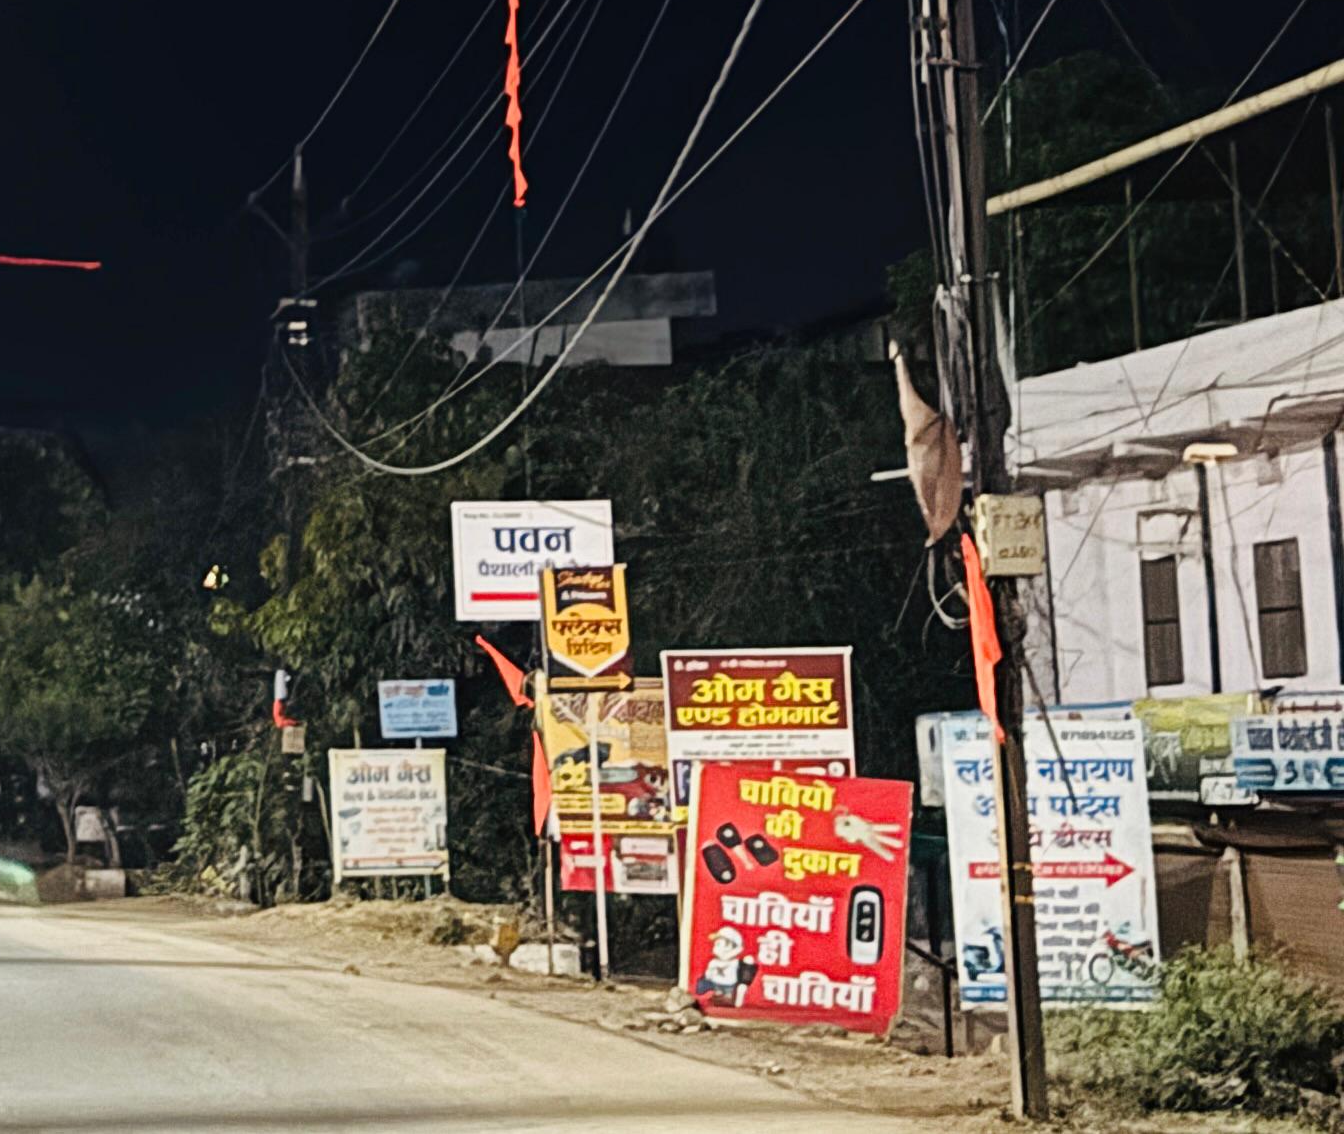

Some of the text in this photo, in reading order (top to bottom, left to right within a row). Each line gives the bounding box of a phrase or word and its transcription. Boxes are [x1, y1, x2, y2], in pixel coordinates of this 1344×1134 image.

[492, 526, 574, 554] पवन
[690, 671, 835, 704] ओम गैस
[676, 706, 733, 727] एण्ड
[736, 700, 841, 727] होममार्ट
[1036, 758, 1134, 782] नारायण
[764, 809, 804, 840] की
[782, 847, 861, 881] दुकान
[757, 929, 794, 967] ही
